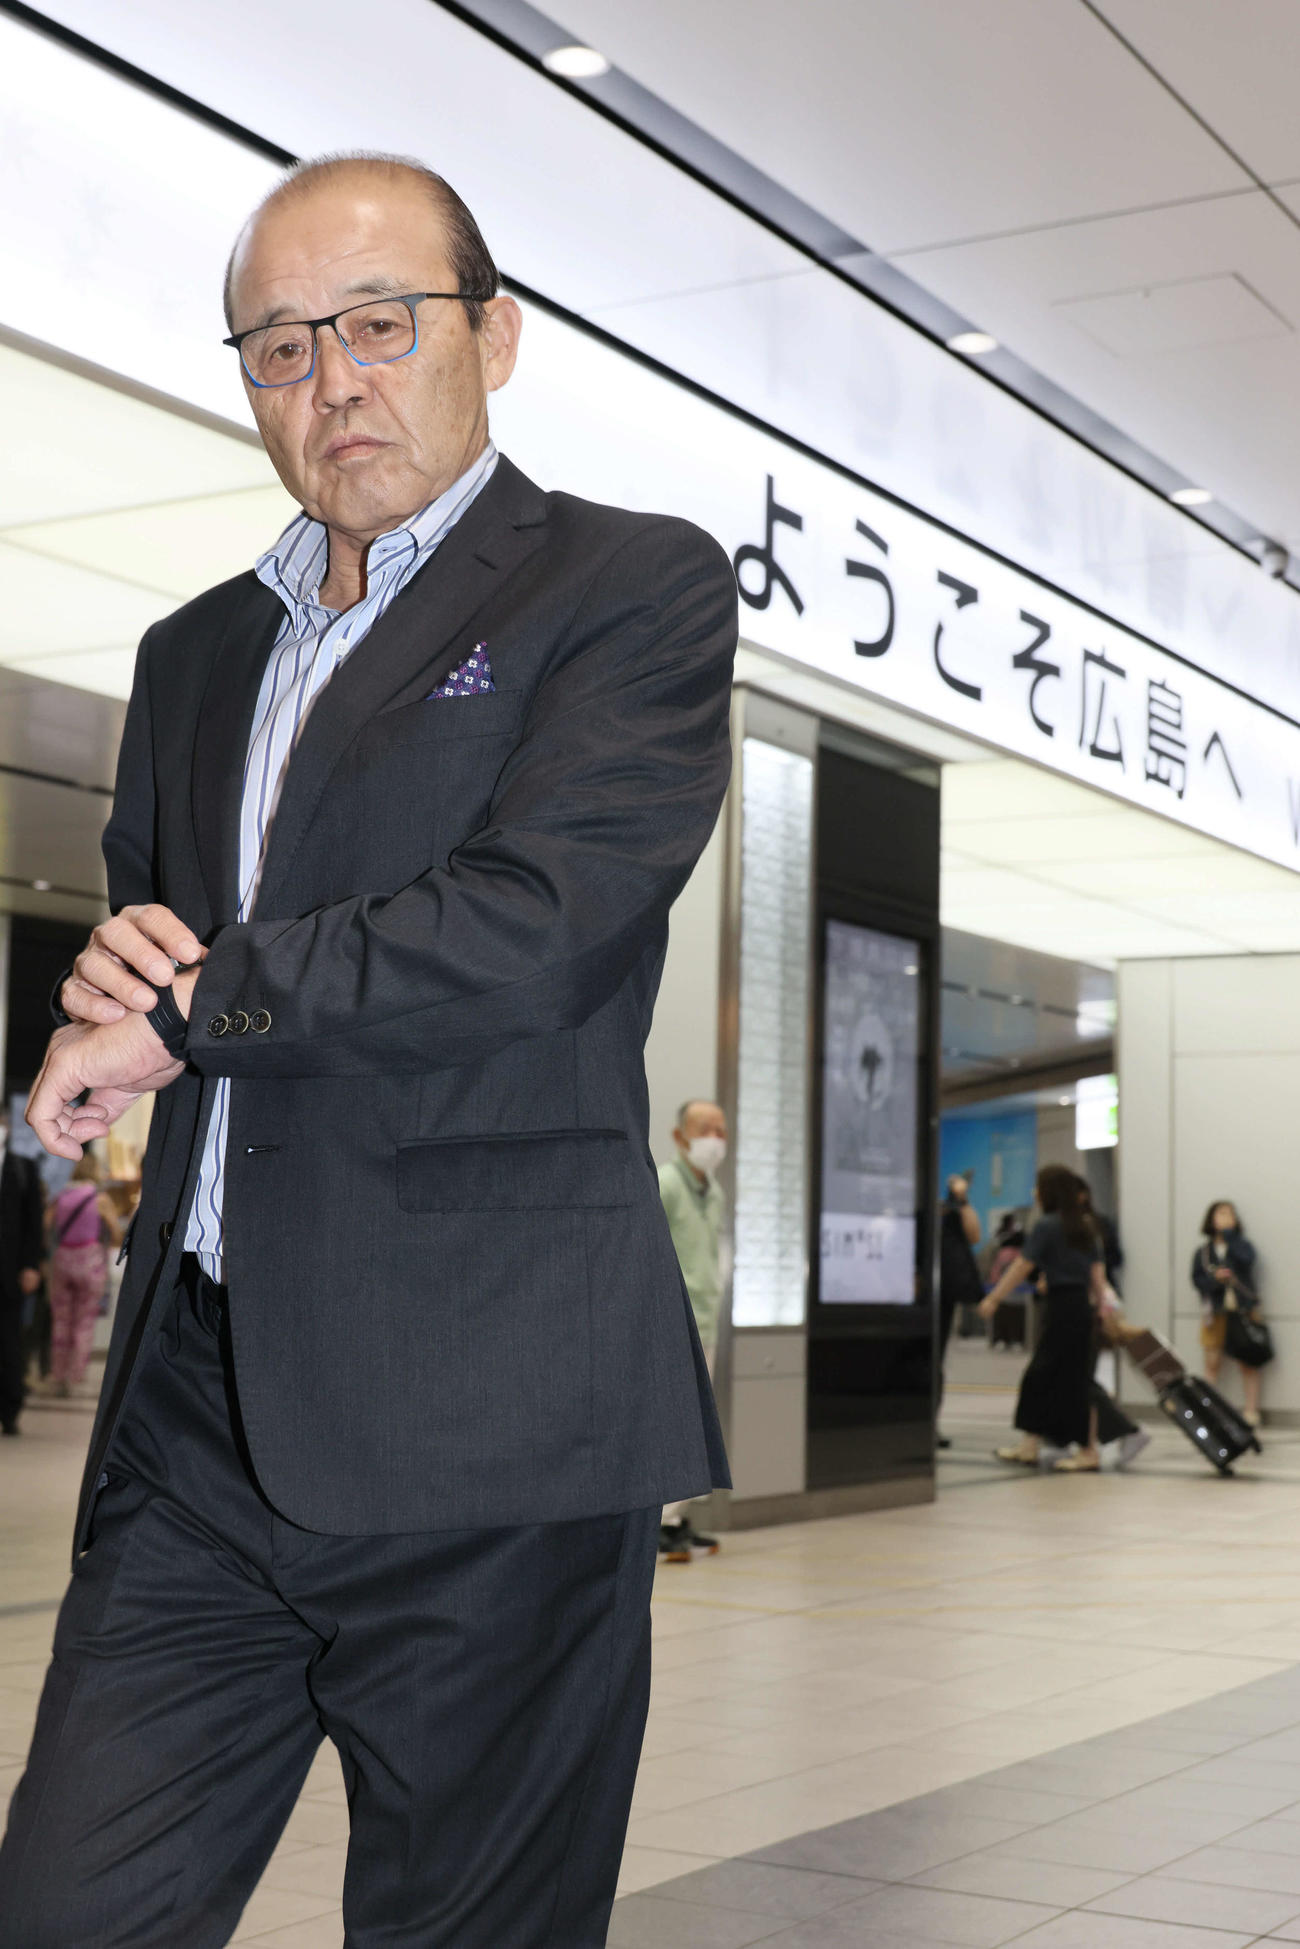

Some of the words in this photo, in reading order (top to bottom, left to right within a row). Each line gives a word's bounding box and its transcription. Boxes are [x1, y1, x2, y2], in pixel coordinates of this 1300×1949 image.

[734, 474, 1242, 800] ようこそ広島へ
